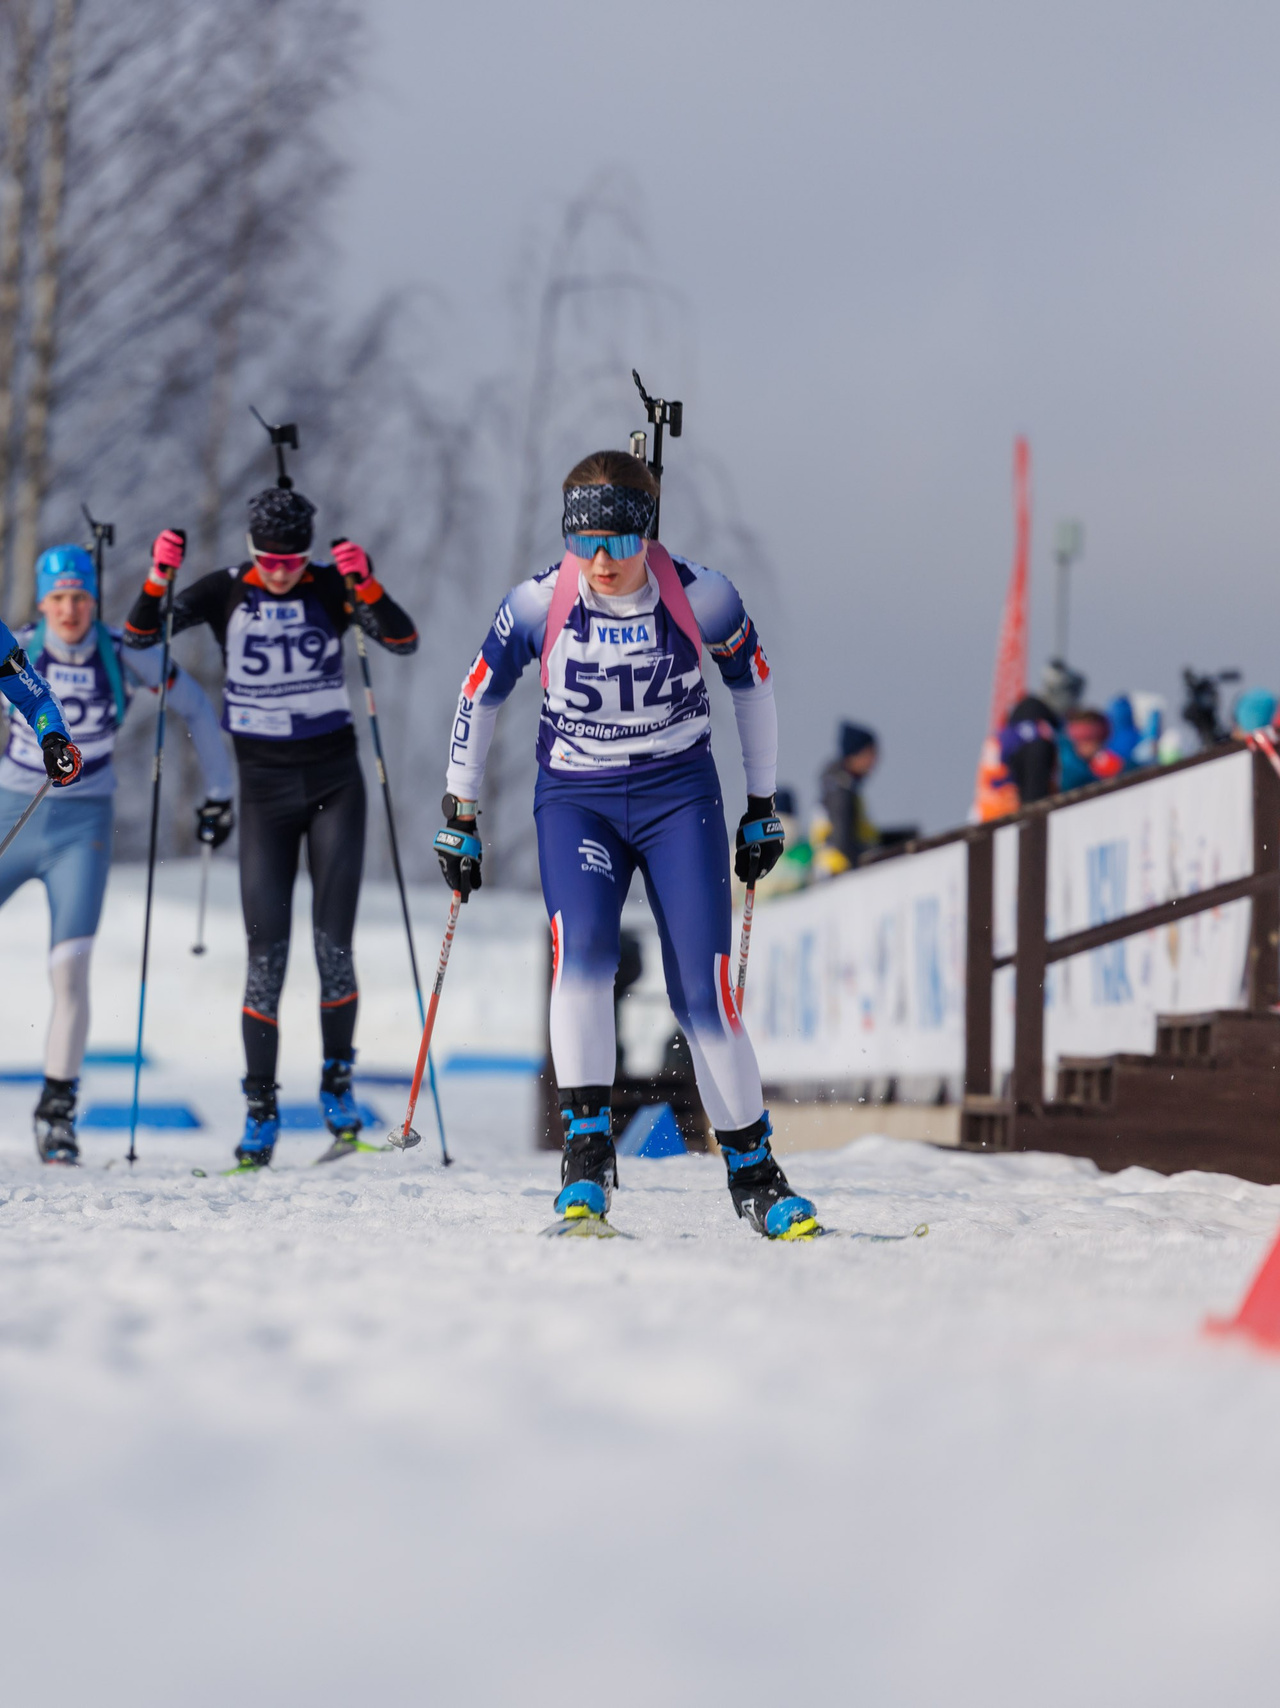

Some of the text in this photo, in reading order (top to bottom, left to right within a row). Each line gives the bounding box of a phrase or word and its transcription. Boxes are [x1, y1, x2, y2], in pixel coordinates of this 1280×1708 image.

[241, 630, 328, 676] 519
[597, 624, 650, 645] VEKA
[565, 654, 689, 714] 514
